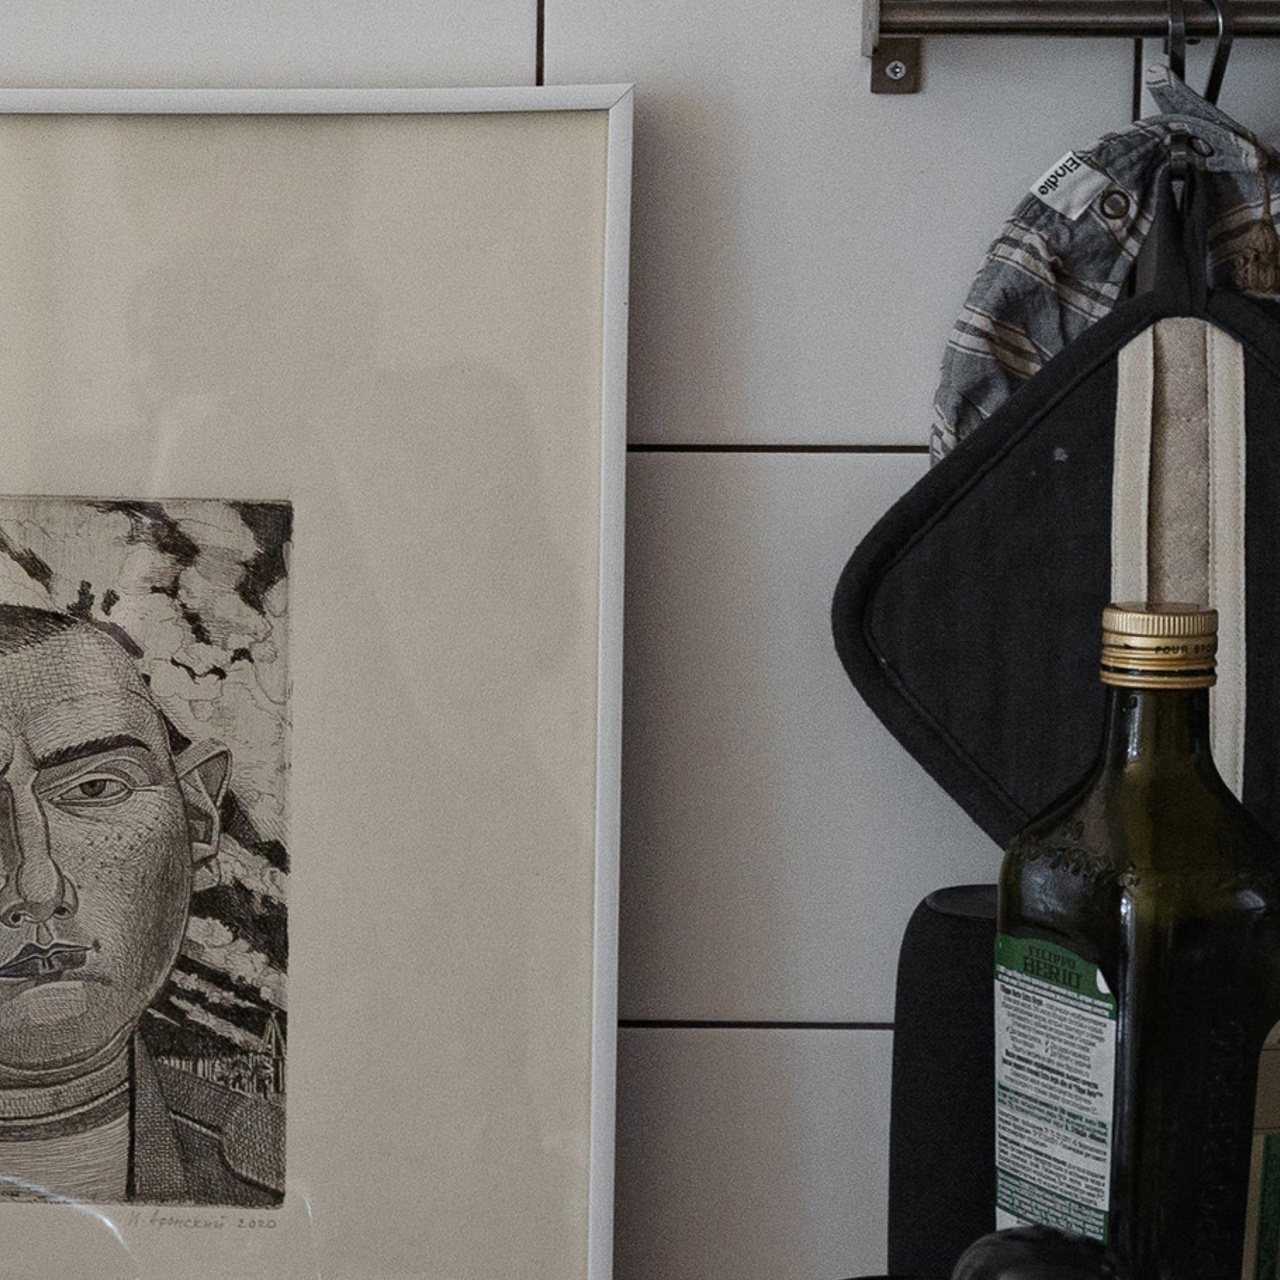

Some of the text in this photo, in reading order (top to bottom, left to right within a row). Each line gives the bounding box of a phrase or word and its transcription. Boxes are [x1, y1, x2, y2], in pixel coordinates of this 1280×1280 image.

[1038, 156, 1082, 195] Elodie
[1023, 955, 1081, 990] BERIO
[237, 1218, 277, 1229] 2020
